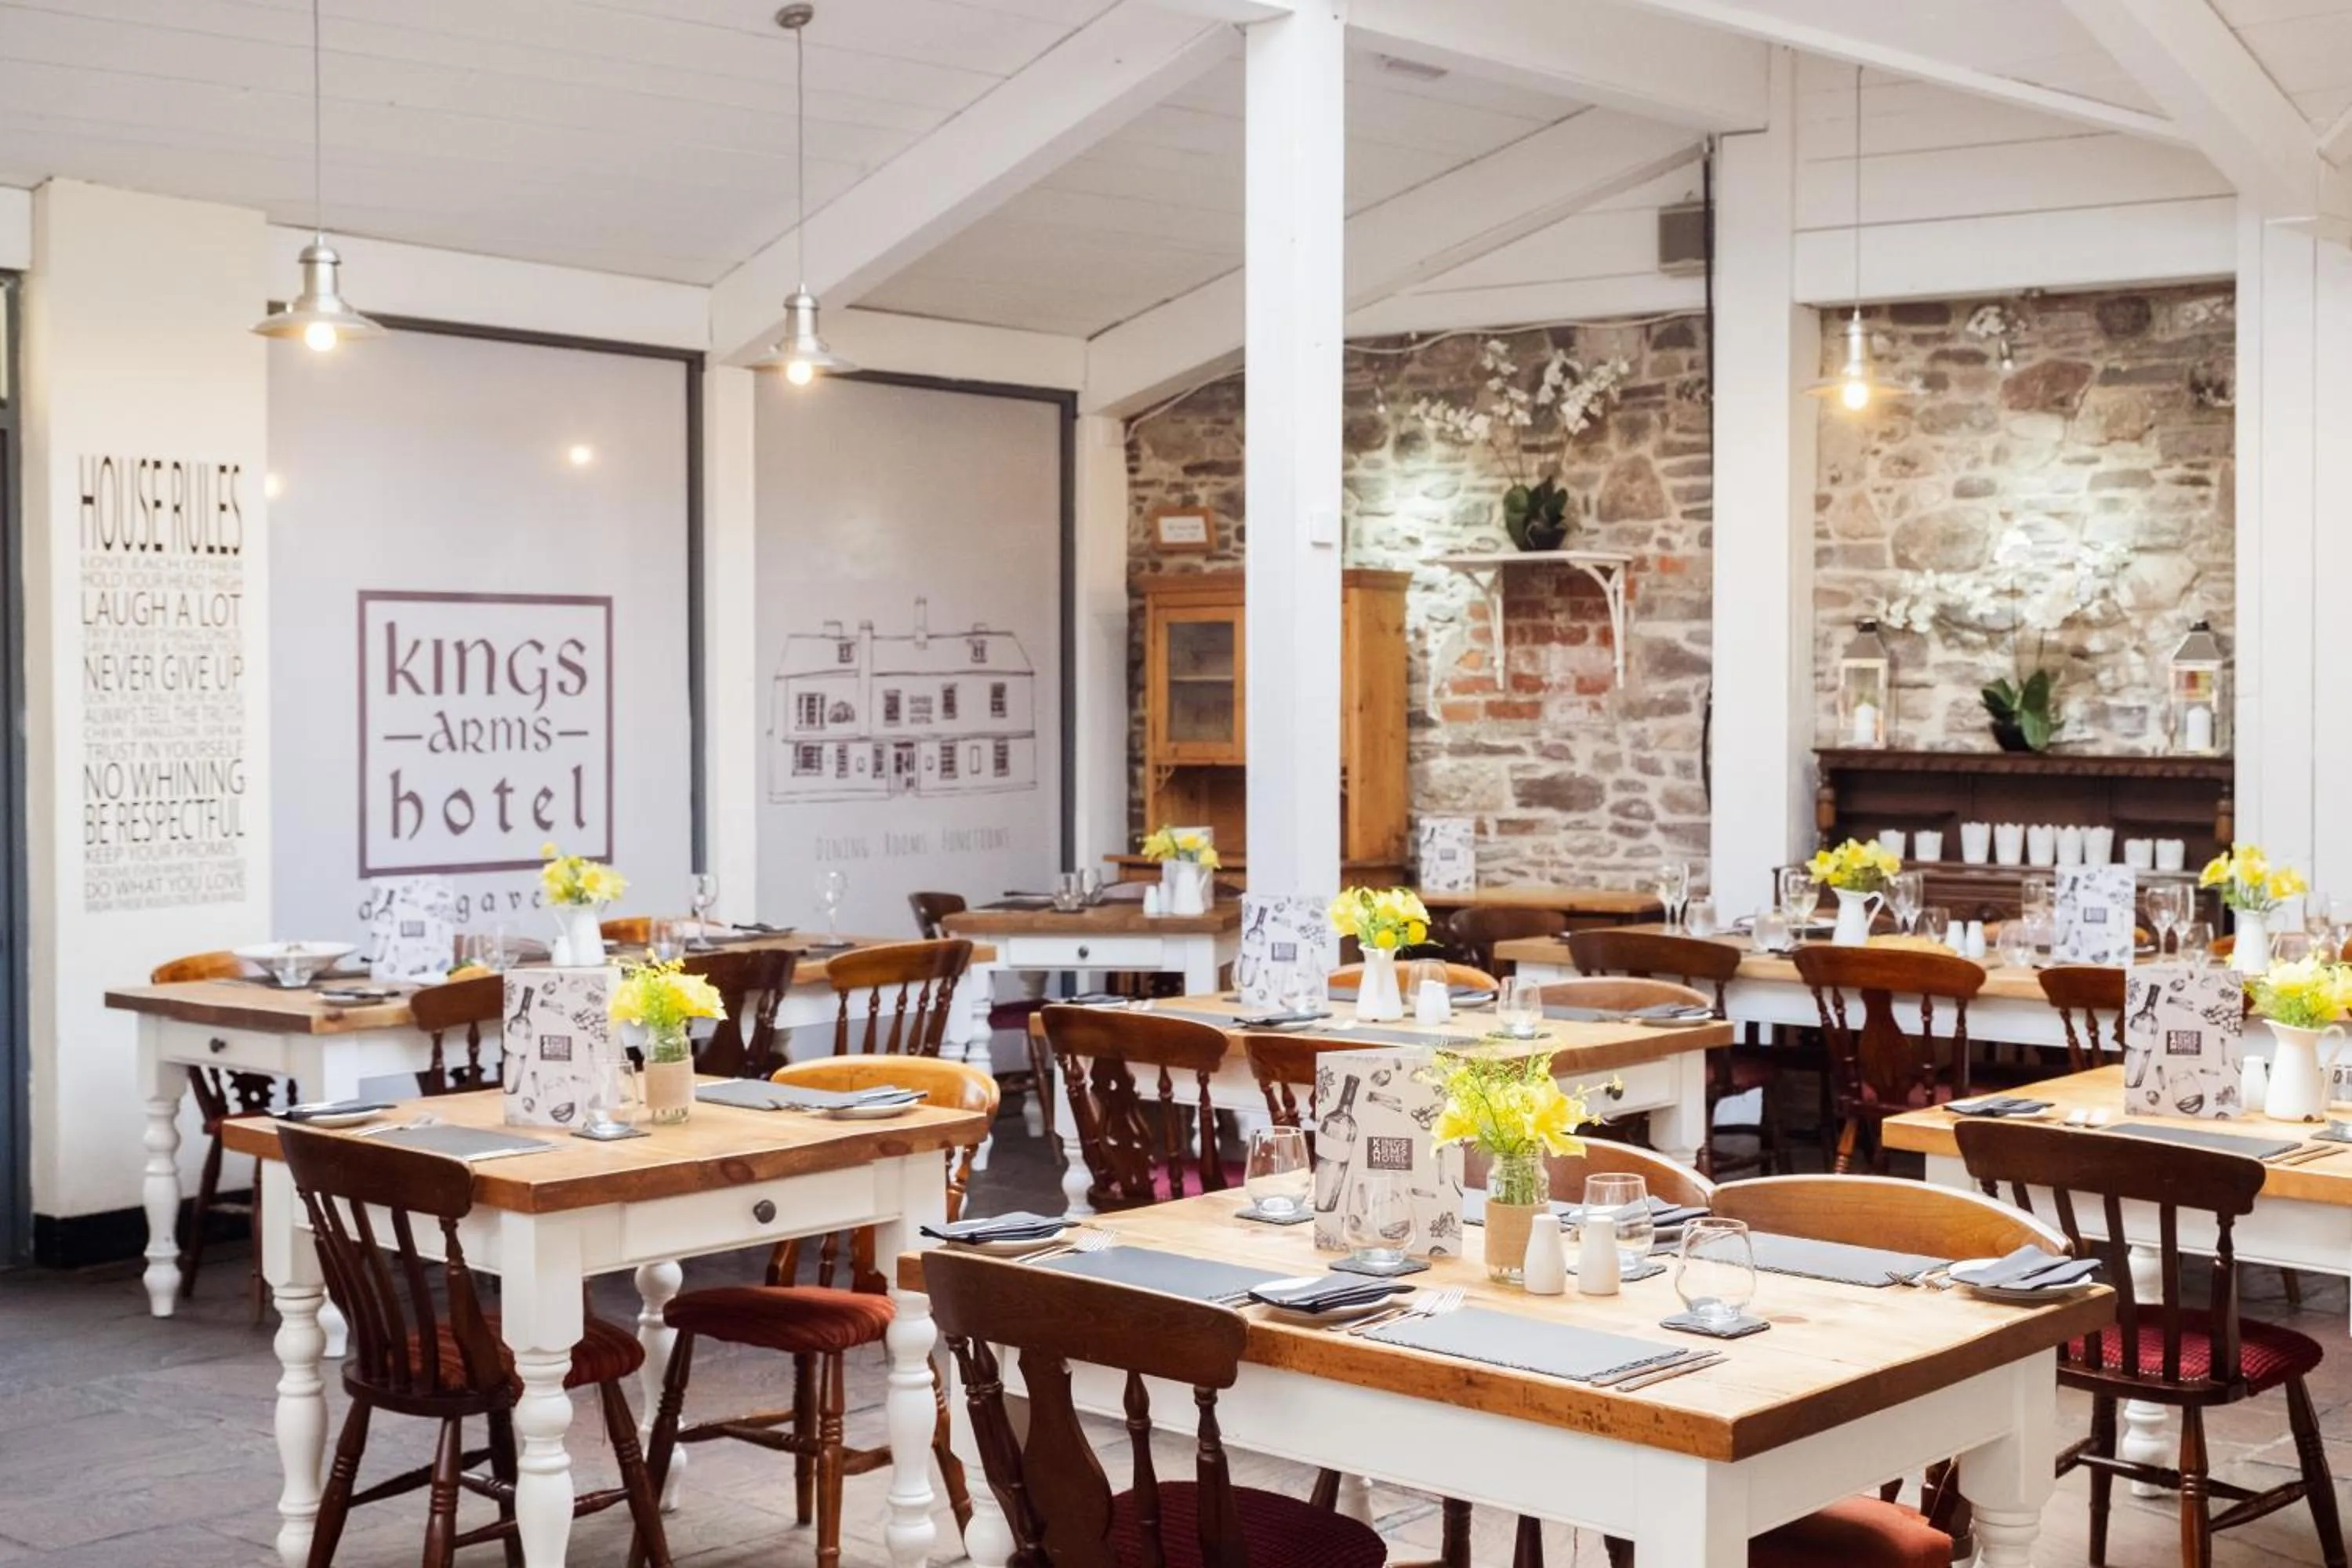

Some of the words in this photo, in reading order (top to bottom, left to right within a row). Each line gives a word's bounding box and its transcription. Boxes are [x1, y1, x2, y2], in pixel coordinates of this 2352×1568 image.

[79, 455, 163, 552] HOUSE
[171, 461, 243, 555] RULES
[81, 591, 168, 626] LAUGH
[175, 593, 193, 626] A
[199, 593, 244, 627] LOT
[83, 654, 155, 691] NEVER
[161, 654, 209, 691] GIVE
[214, 654, 245, 691] UP
[83, 761, 125, 800] NO
[129, 758, 245, 797] WHINING
[84, 803, 109, 846] BE
[117, 798, 245, 844] RESPECTFUL
[390, 764, 586, 840] hotel
